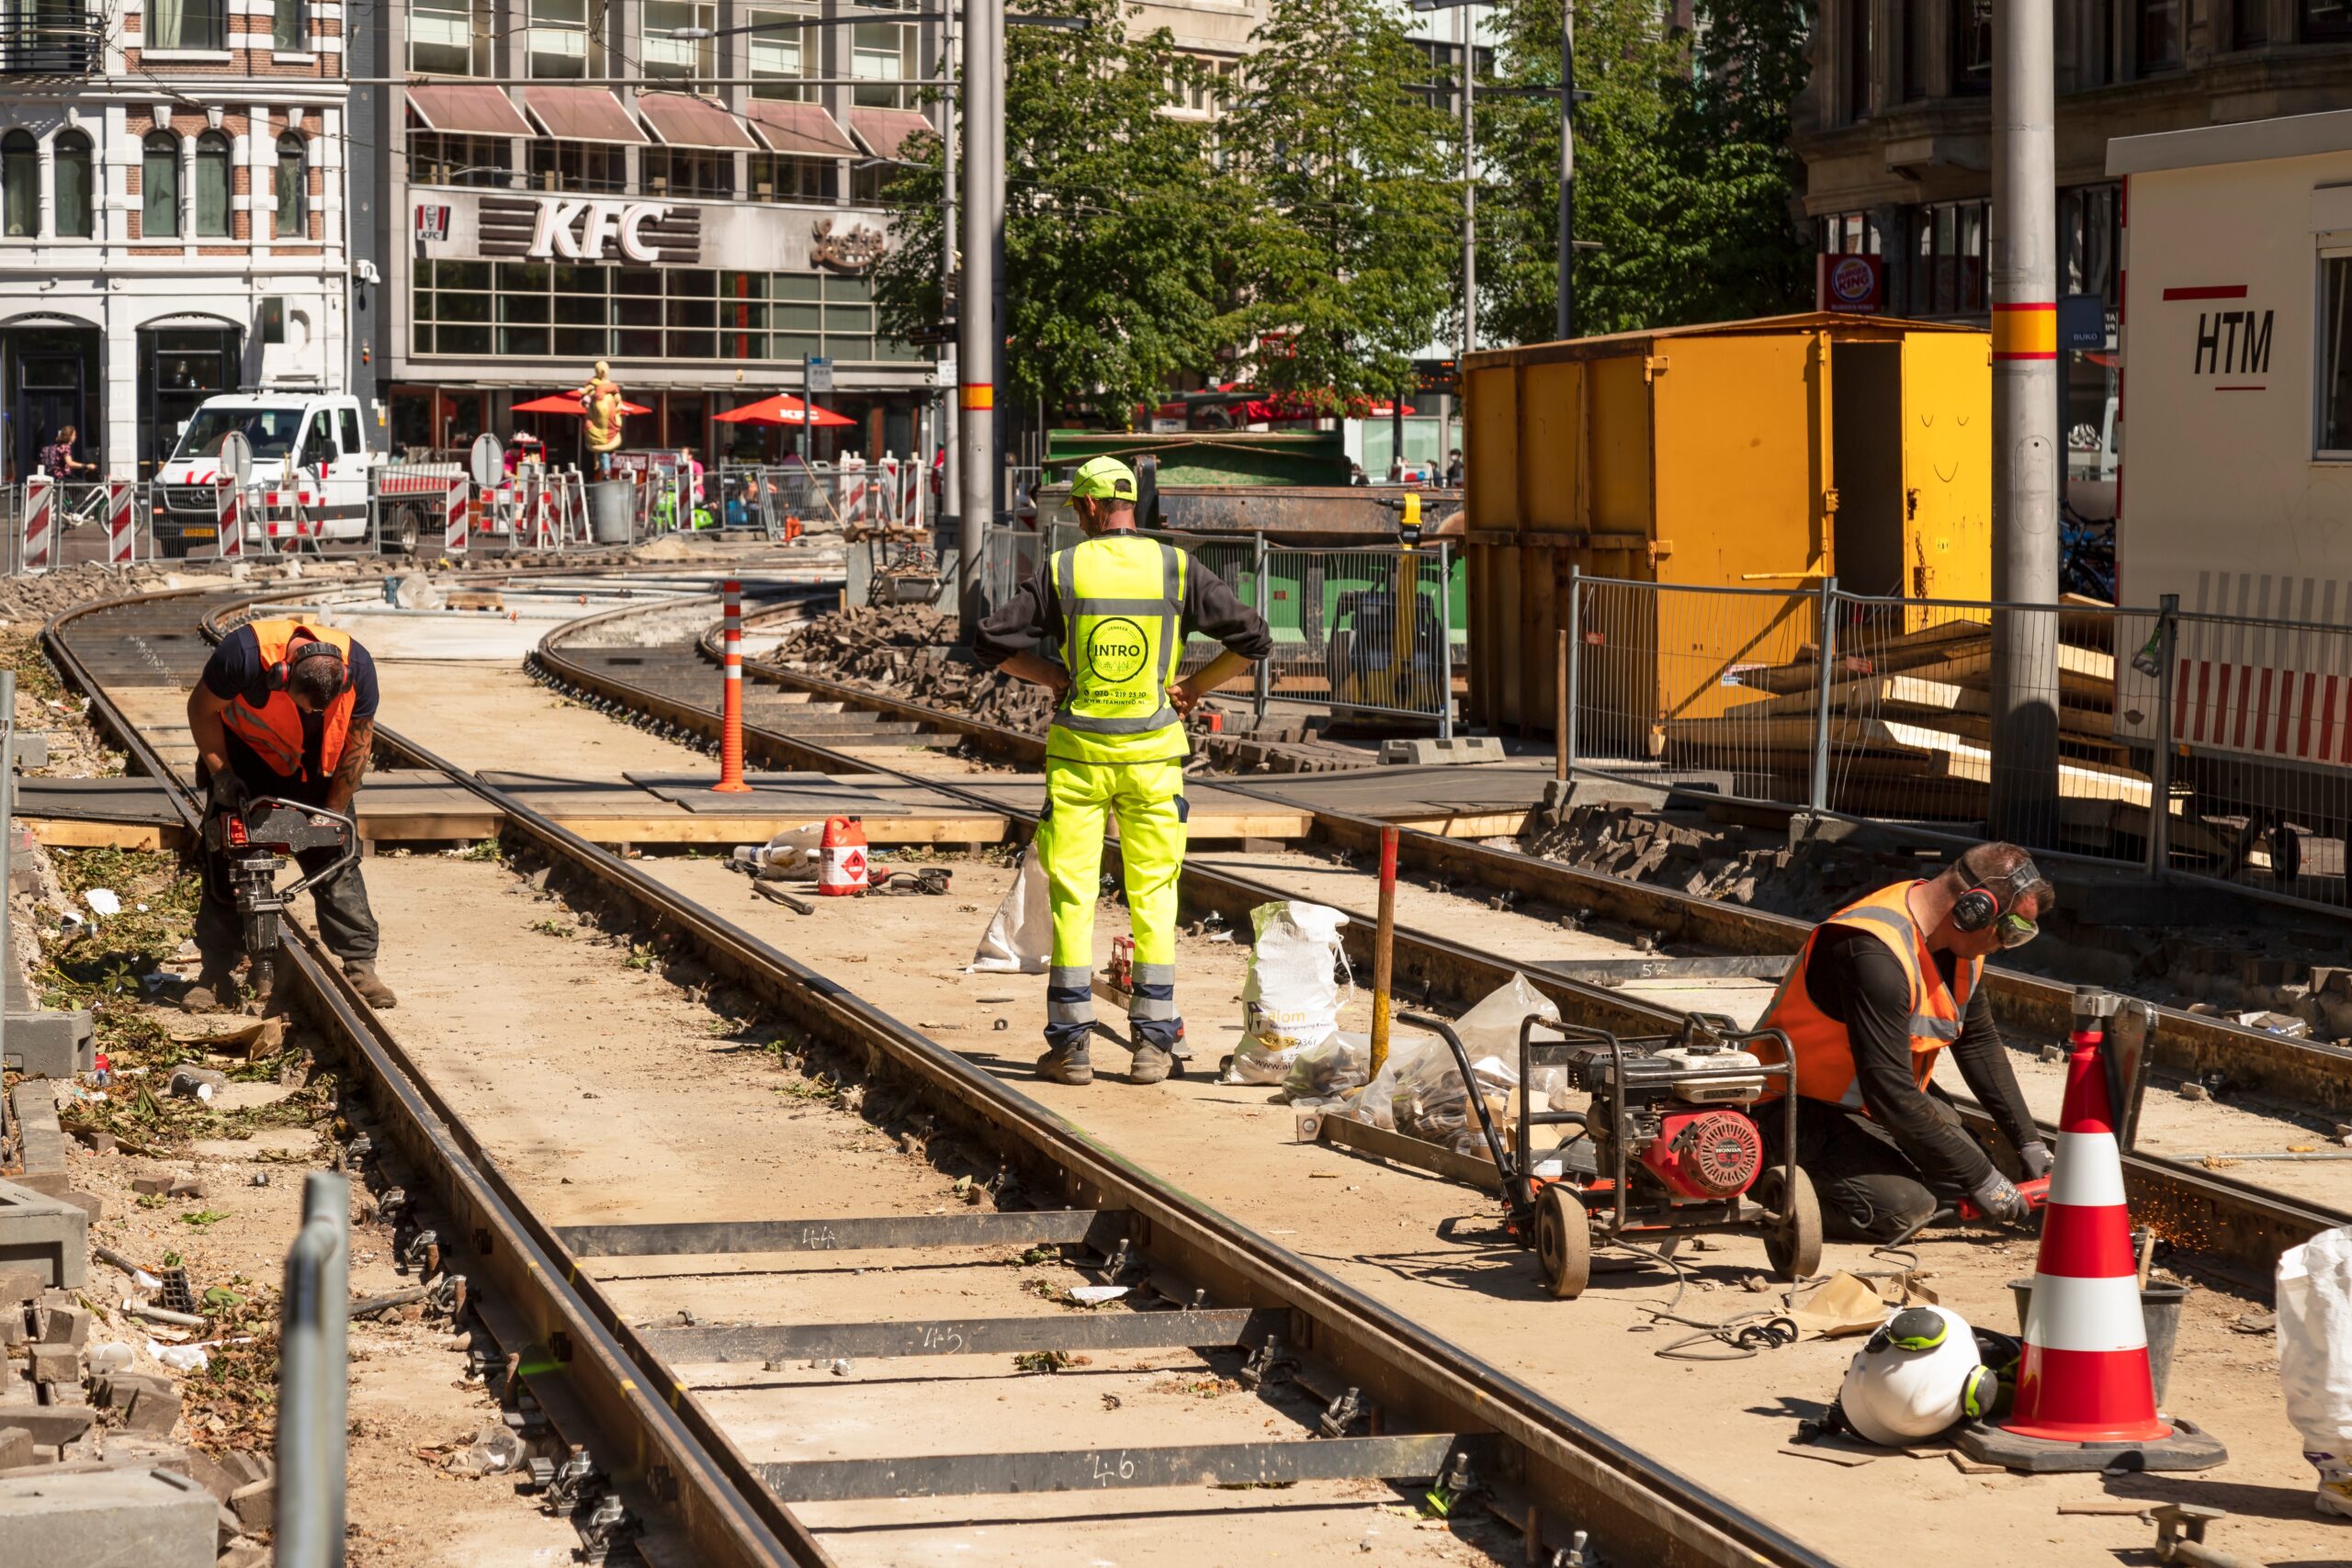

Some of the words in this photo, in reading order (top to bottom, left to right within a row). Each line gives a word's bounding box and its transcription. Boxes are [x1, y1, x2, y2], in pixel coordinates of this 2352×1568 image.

[420, 231, 440, 240] KFC
[527, 197, 673, 262] KFC
[1838, 274, 1870, 291] KING
[2073, 333, 2098, 341] BUKO
[2194, 310, 2274, 374] HTM
[1094, 644, 1140, 657] INTRO
[1643, 964, 1668, 977] 57
[1268, 1009, 1306, 1024] alom
[1255, 1059, 1293, 1070] www.al
[802, 1226, 835, 1249] 44
[923, 1325, 964, 1354] 45
[1093, 1450, 1135, 1487] 46
